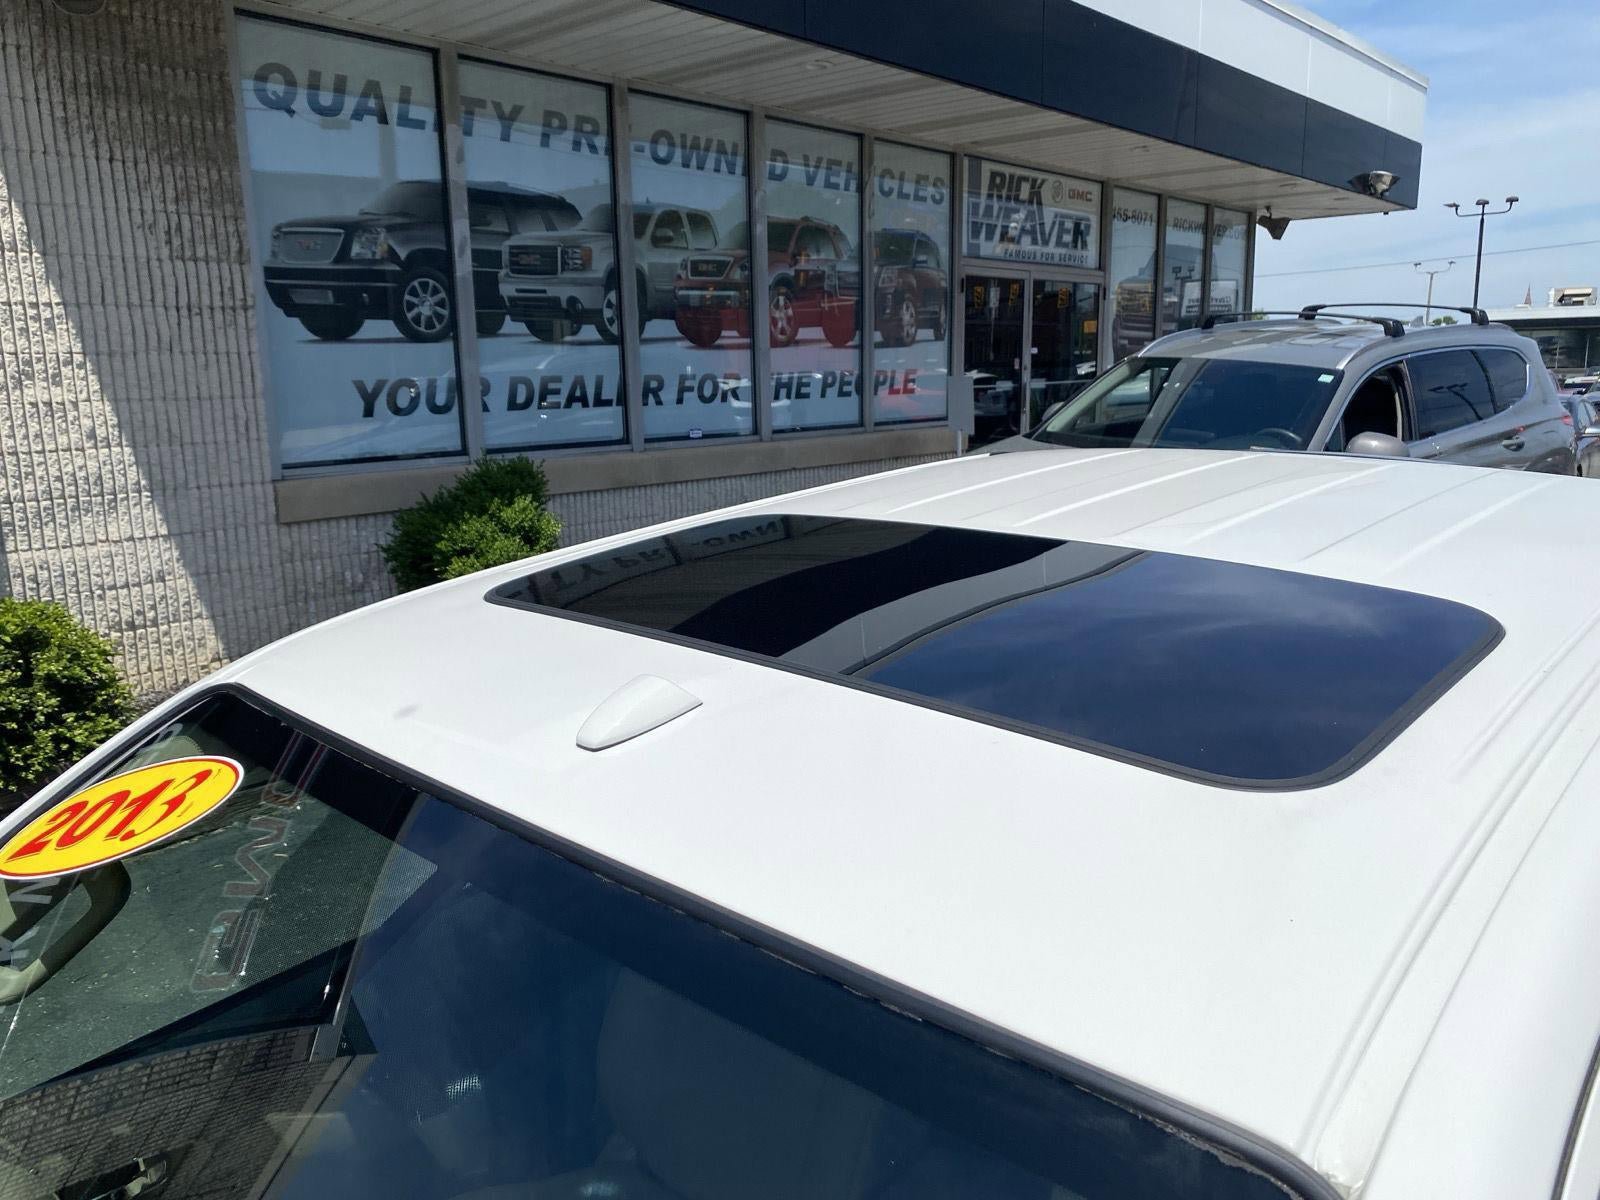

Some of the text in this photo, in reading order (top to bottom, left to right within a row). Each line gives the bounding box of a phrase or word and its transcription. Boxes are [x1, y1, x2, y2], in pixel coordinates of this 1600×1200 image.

[253, 62, 945, 205] QUALTY PR-OWND VEHCLES
[986, 170, 1047, 205] RICK
[1068, 188, 1092, 202] GMC
[970, 201, 1092, 250] WEAVER
[1003, 248, 1037, 260] FAMOUS
[1040, 251, 1055, 262] FOR
[676, 372, 741, 405] FOR
[771, 370, 812, 401] HE
[6, 769, 214, 863] 2013
